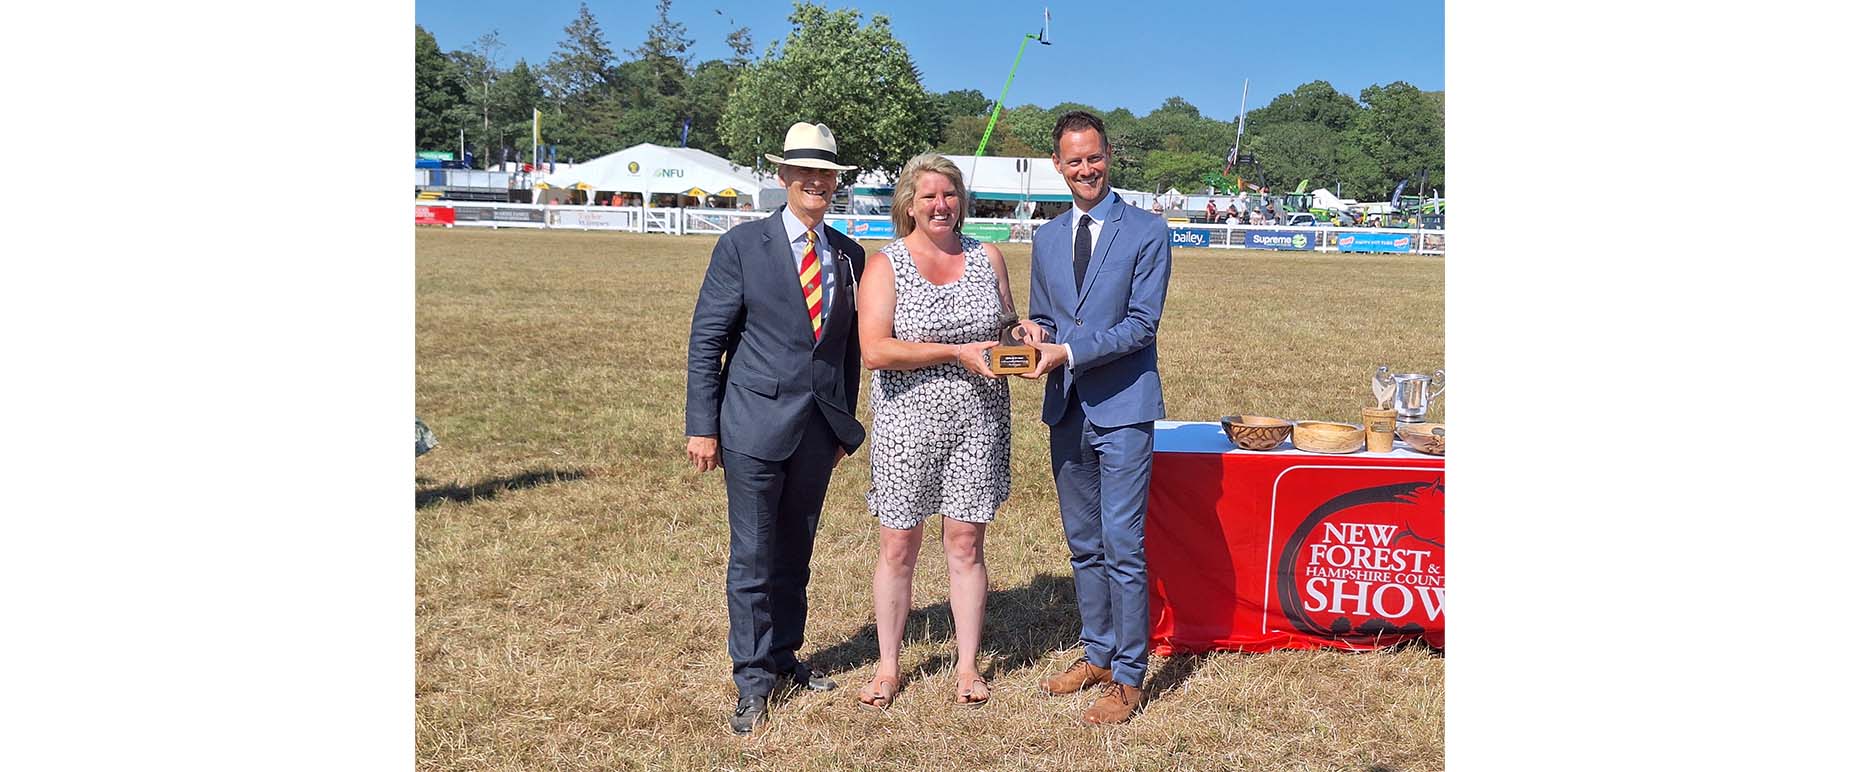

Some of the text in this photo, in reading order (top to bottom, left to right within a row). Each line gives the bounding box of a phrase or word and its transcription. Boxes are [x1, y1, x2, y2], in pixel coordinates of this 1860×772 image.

[662, 168, 684, 178] NFU
[1253, 234, 1292, 244] Supreme
[1322, 522, 1398, 546] NEW
[1309, 544, 1440, 574] FOREST &
[1306, 566, 1391, 582] HAMPSHIRE
[1304, 577, 1445, 621] SHOW
